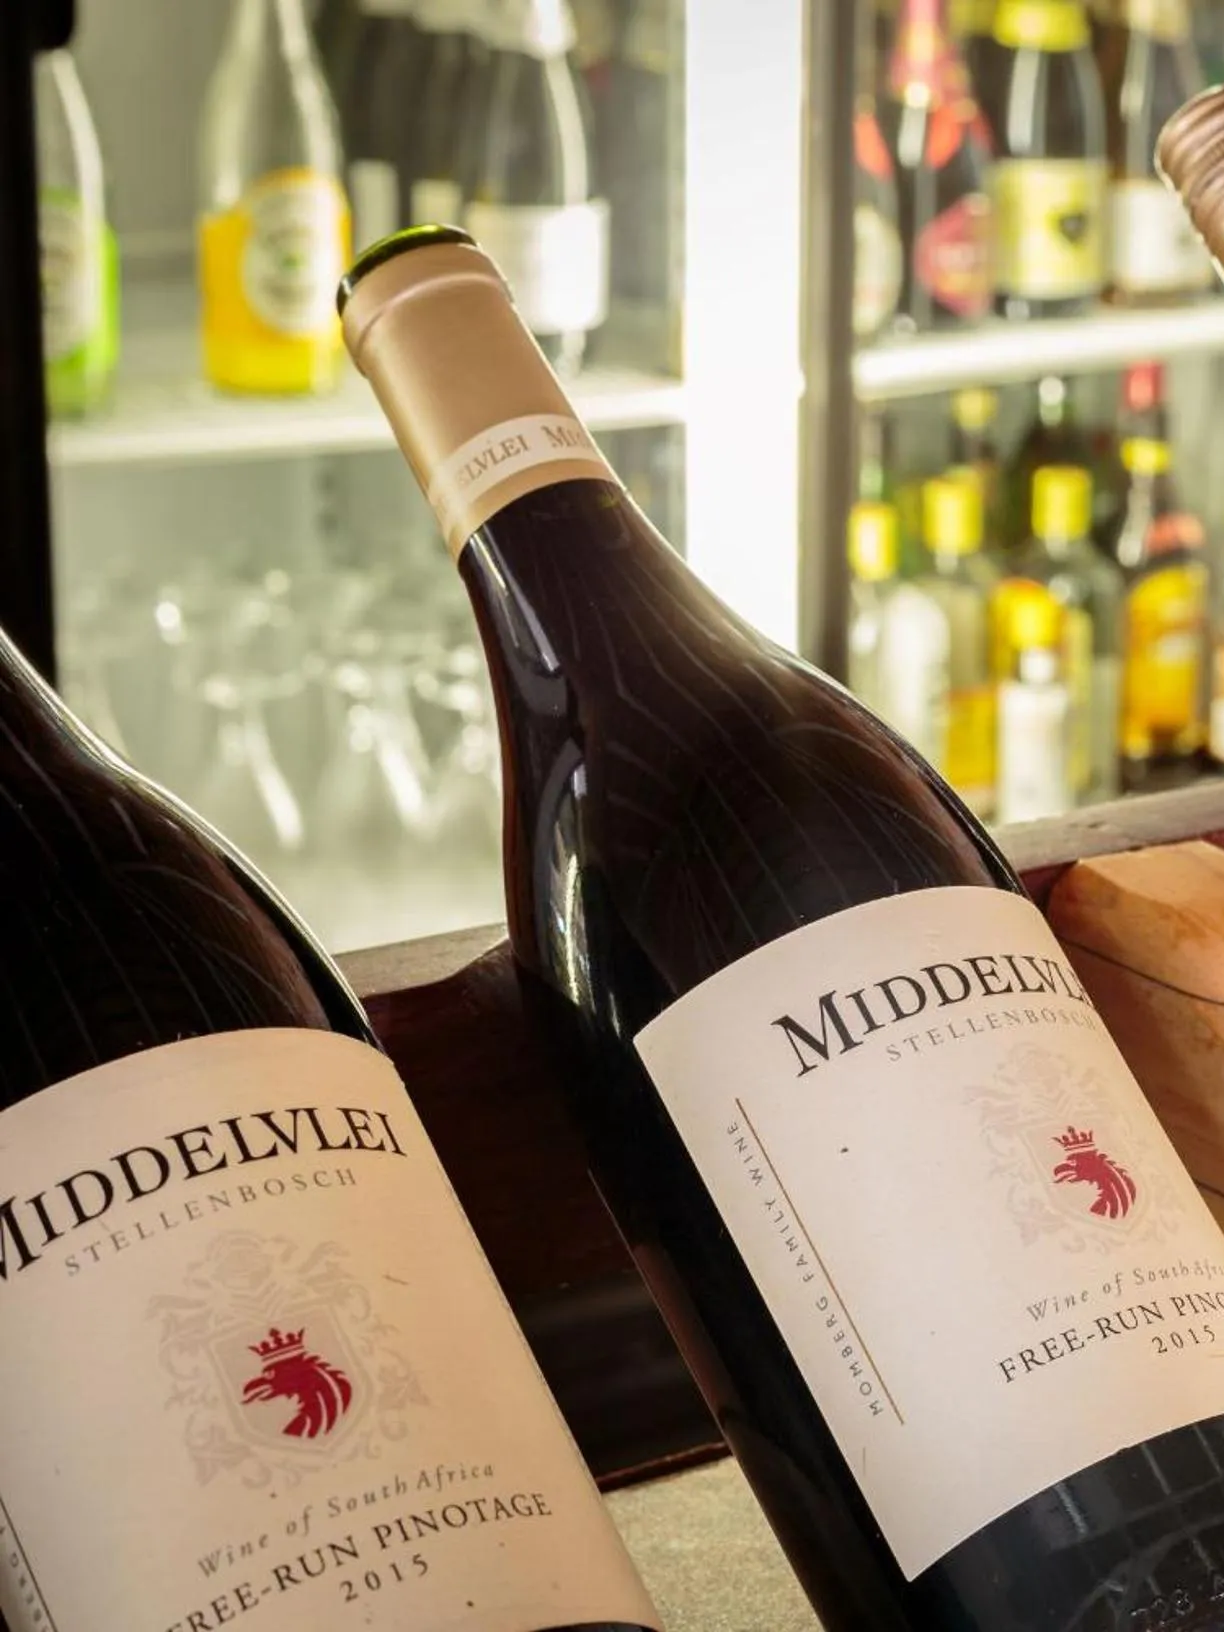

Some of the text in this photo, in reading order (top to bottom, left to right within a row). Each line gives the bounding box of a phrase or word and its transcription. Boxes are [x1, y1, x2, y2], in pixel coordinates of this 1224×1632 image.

[770, 954, 1088, 1078] MIDDELVL
[64, 1167, 358, 1277] STELLENBOSCH
[726, 1121, 884, 1417] MOMBERG FAMILY WINE
[1025, 1290, 1090, 1323] Wine
[1102, 1271, 1124, 1296] of
[1132, 1260, 1189, 1286] South
[996, 1301, 1165, 1383] FREE-RUN
[1151, 1324, 1216, 1354] 2015
[197, 1462, 494, 1578] Wine of South Africa
[372, 1492, 552, 1550] PINOTAGE
[339, 1553, 429, 1603] 2015
